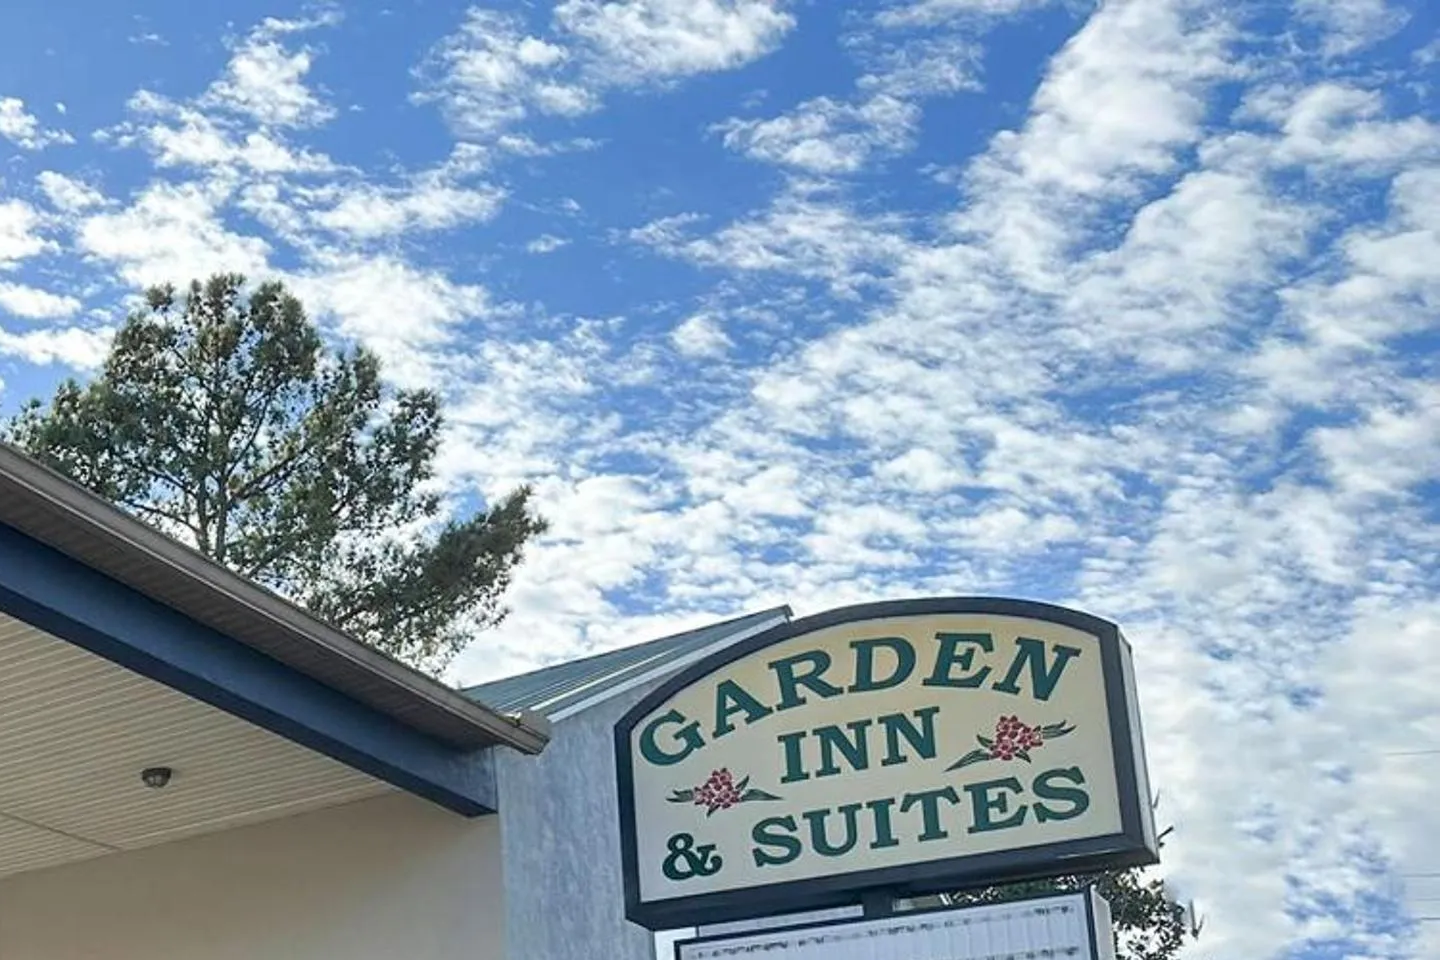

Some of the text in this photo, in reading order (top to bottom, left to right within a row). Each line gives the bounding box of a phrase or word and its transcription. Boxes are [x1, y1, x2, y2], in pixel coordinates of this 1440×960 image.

[640, 632, 1081, 766] GARDEN
[777, 706, 939, 783] INN
[662, 766, 1090, 881] & SUITES
